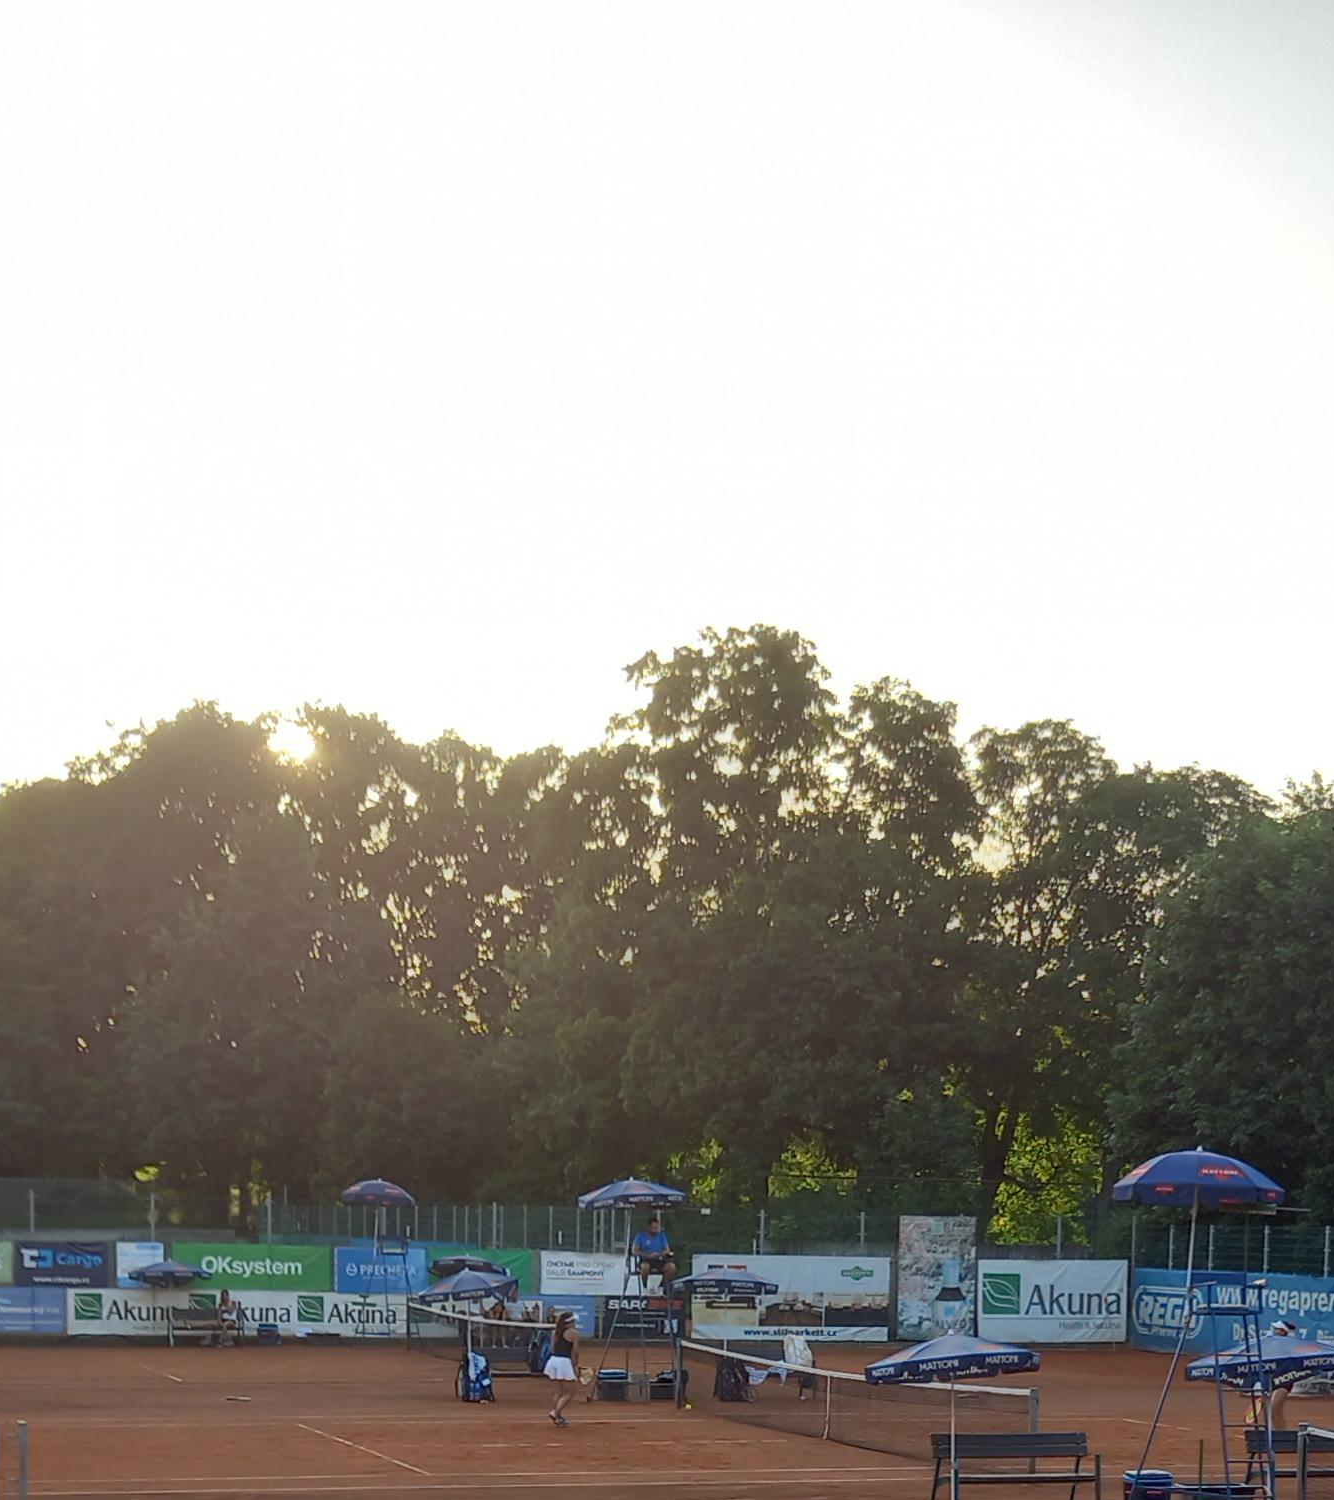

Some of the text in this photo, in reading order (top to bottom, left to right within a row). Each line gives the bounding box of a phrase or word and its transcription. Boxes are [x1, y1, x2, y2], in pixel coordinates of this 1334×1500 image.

[56, 1252, 102, 1270] Cargo
[201, 1255, 303, 1278] OKsystem
[1025, 1284, 1121, 1315] Akuna
[106, 1300, 174, 1322] Akun
[328, 1303, 397, 1324] Akuna
[1139, 1295, 1196, 1328] REGA
[919, 1359, 959, 1372] MATTONI
